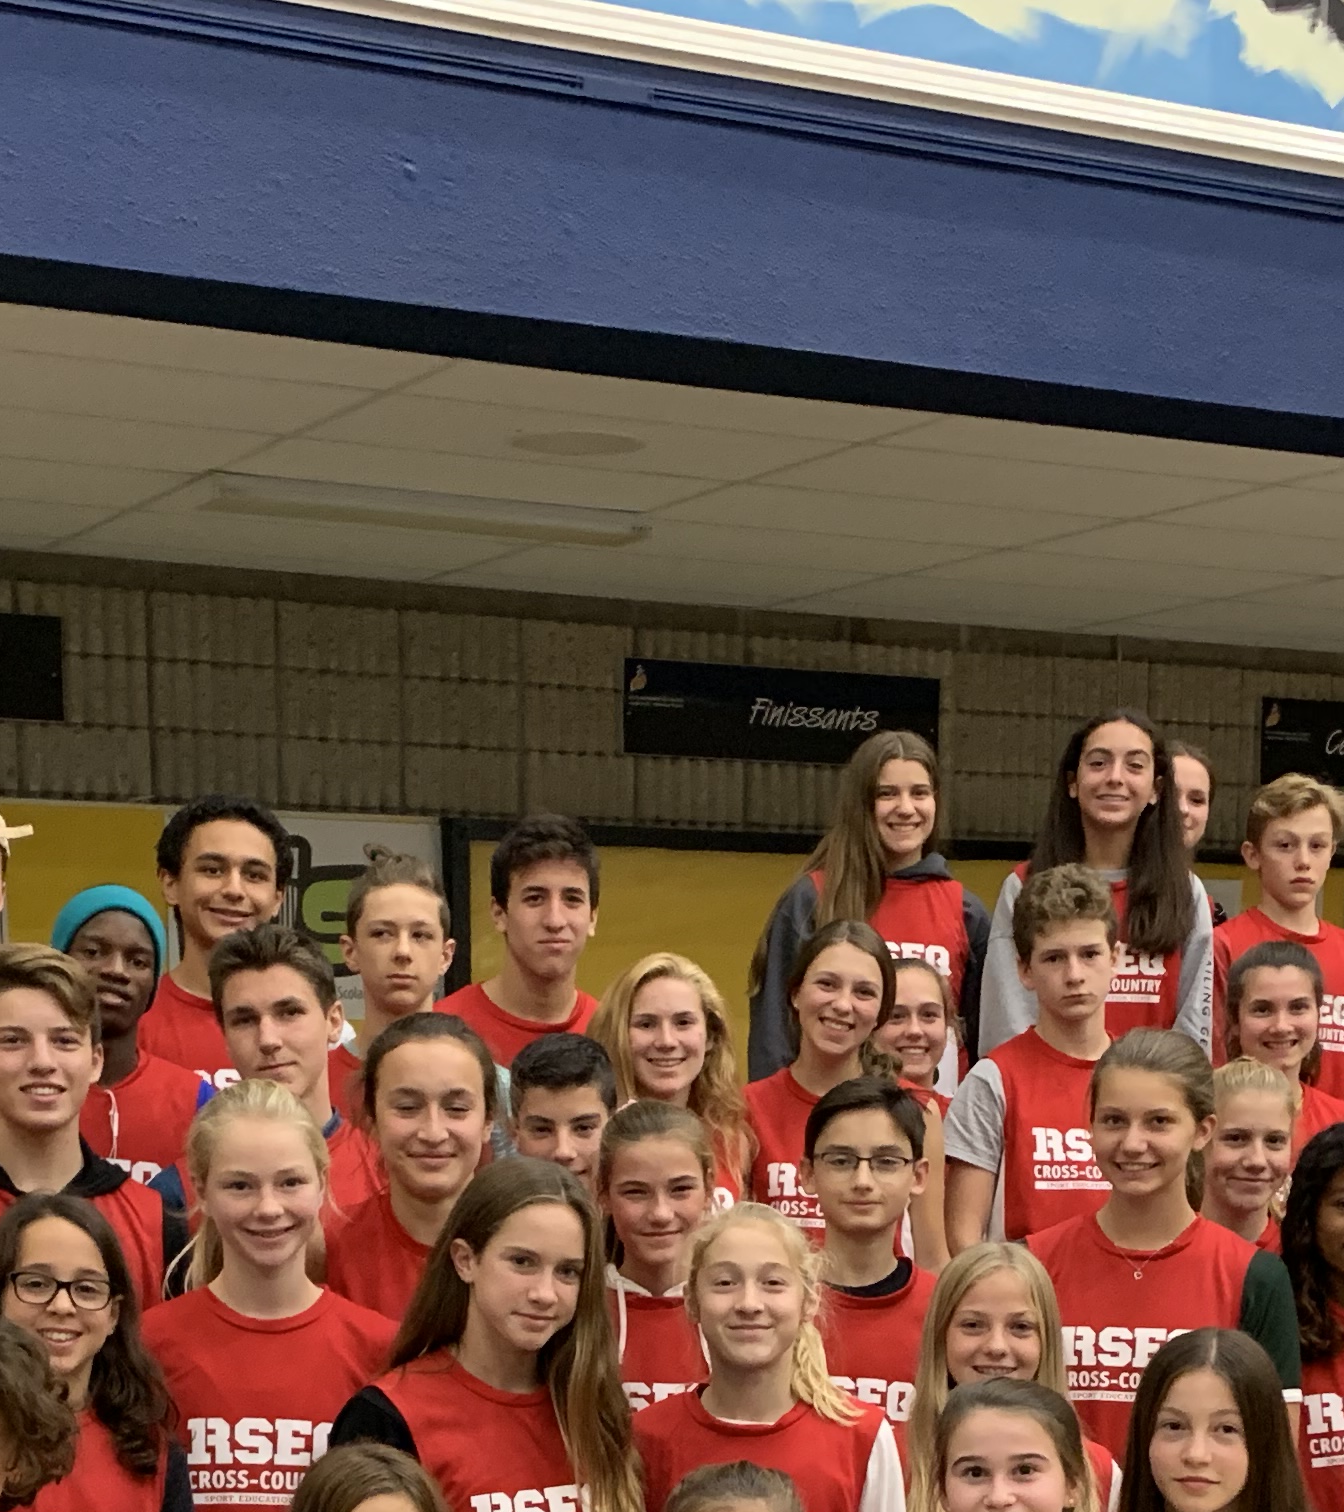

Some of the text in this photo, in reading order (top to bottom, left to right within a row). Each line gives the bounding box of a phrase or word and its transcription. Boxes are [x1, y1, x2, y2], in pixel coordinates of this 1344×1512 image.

[748, 697, 879, 731] Finissants
[336, 985, 364, 1000] Scola
[1032, 1127, 1097, 1162] RS
[1034, 1164, 1103, 1179] CROSS-CO
[1061, 1325, 1194, 1368] RSE
[1067, 1370, 1140, 1389] ROSS-CO
[189, 1469, 305, 1490] CROSS-COU
